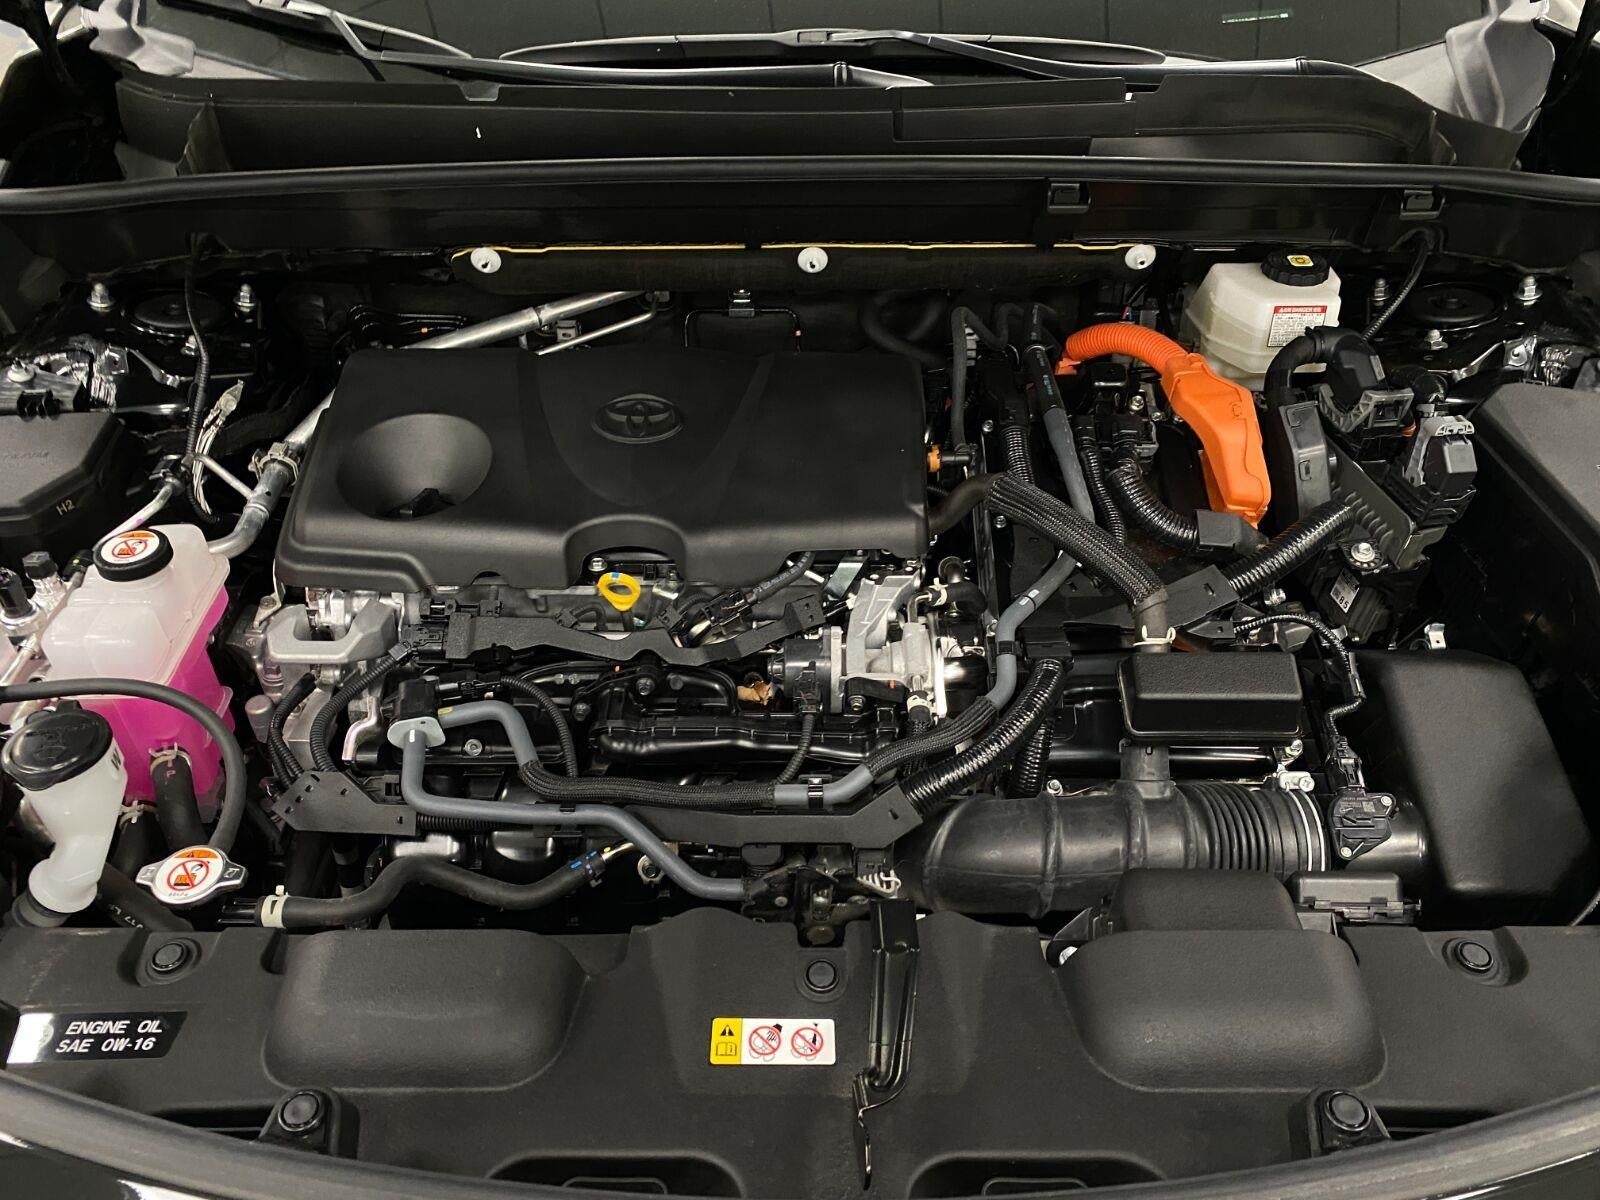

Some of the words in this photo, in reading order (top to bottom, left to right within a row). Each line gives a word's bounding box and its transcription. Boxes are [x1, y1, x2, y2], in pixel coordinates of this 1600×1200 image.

[56, 499, 76, 516] H2
[65, 1020, 130, 1034] ENGINE
[137, 1020, 162, 1033] OIL
[56, 1038, 94, 1052] SAE
[101, 1037, 156, 1051] 0W-16
